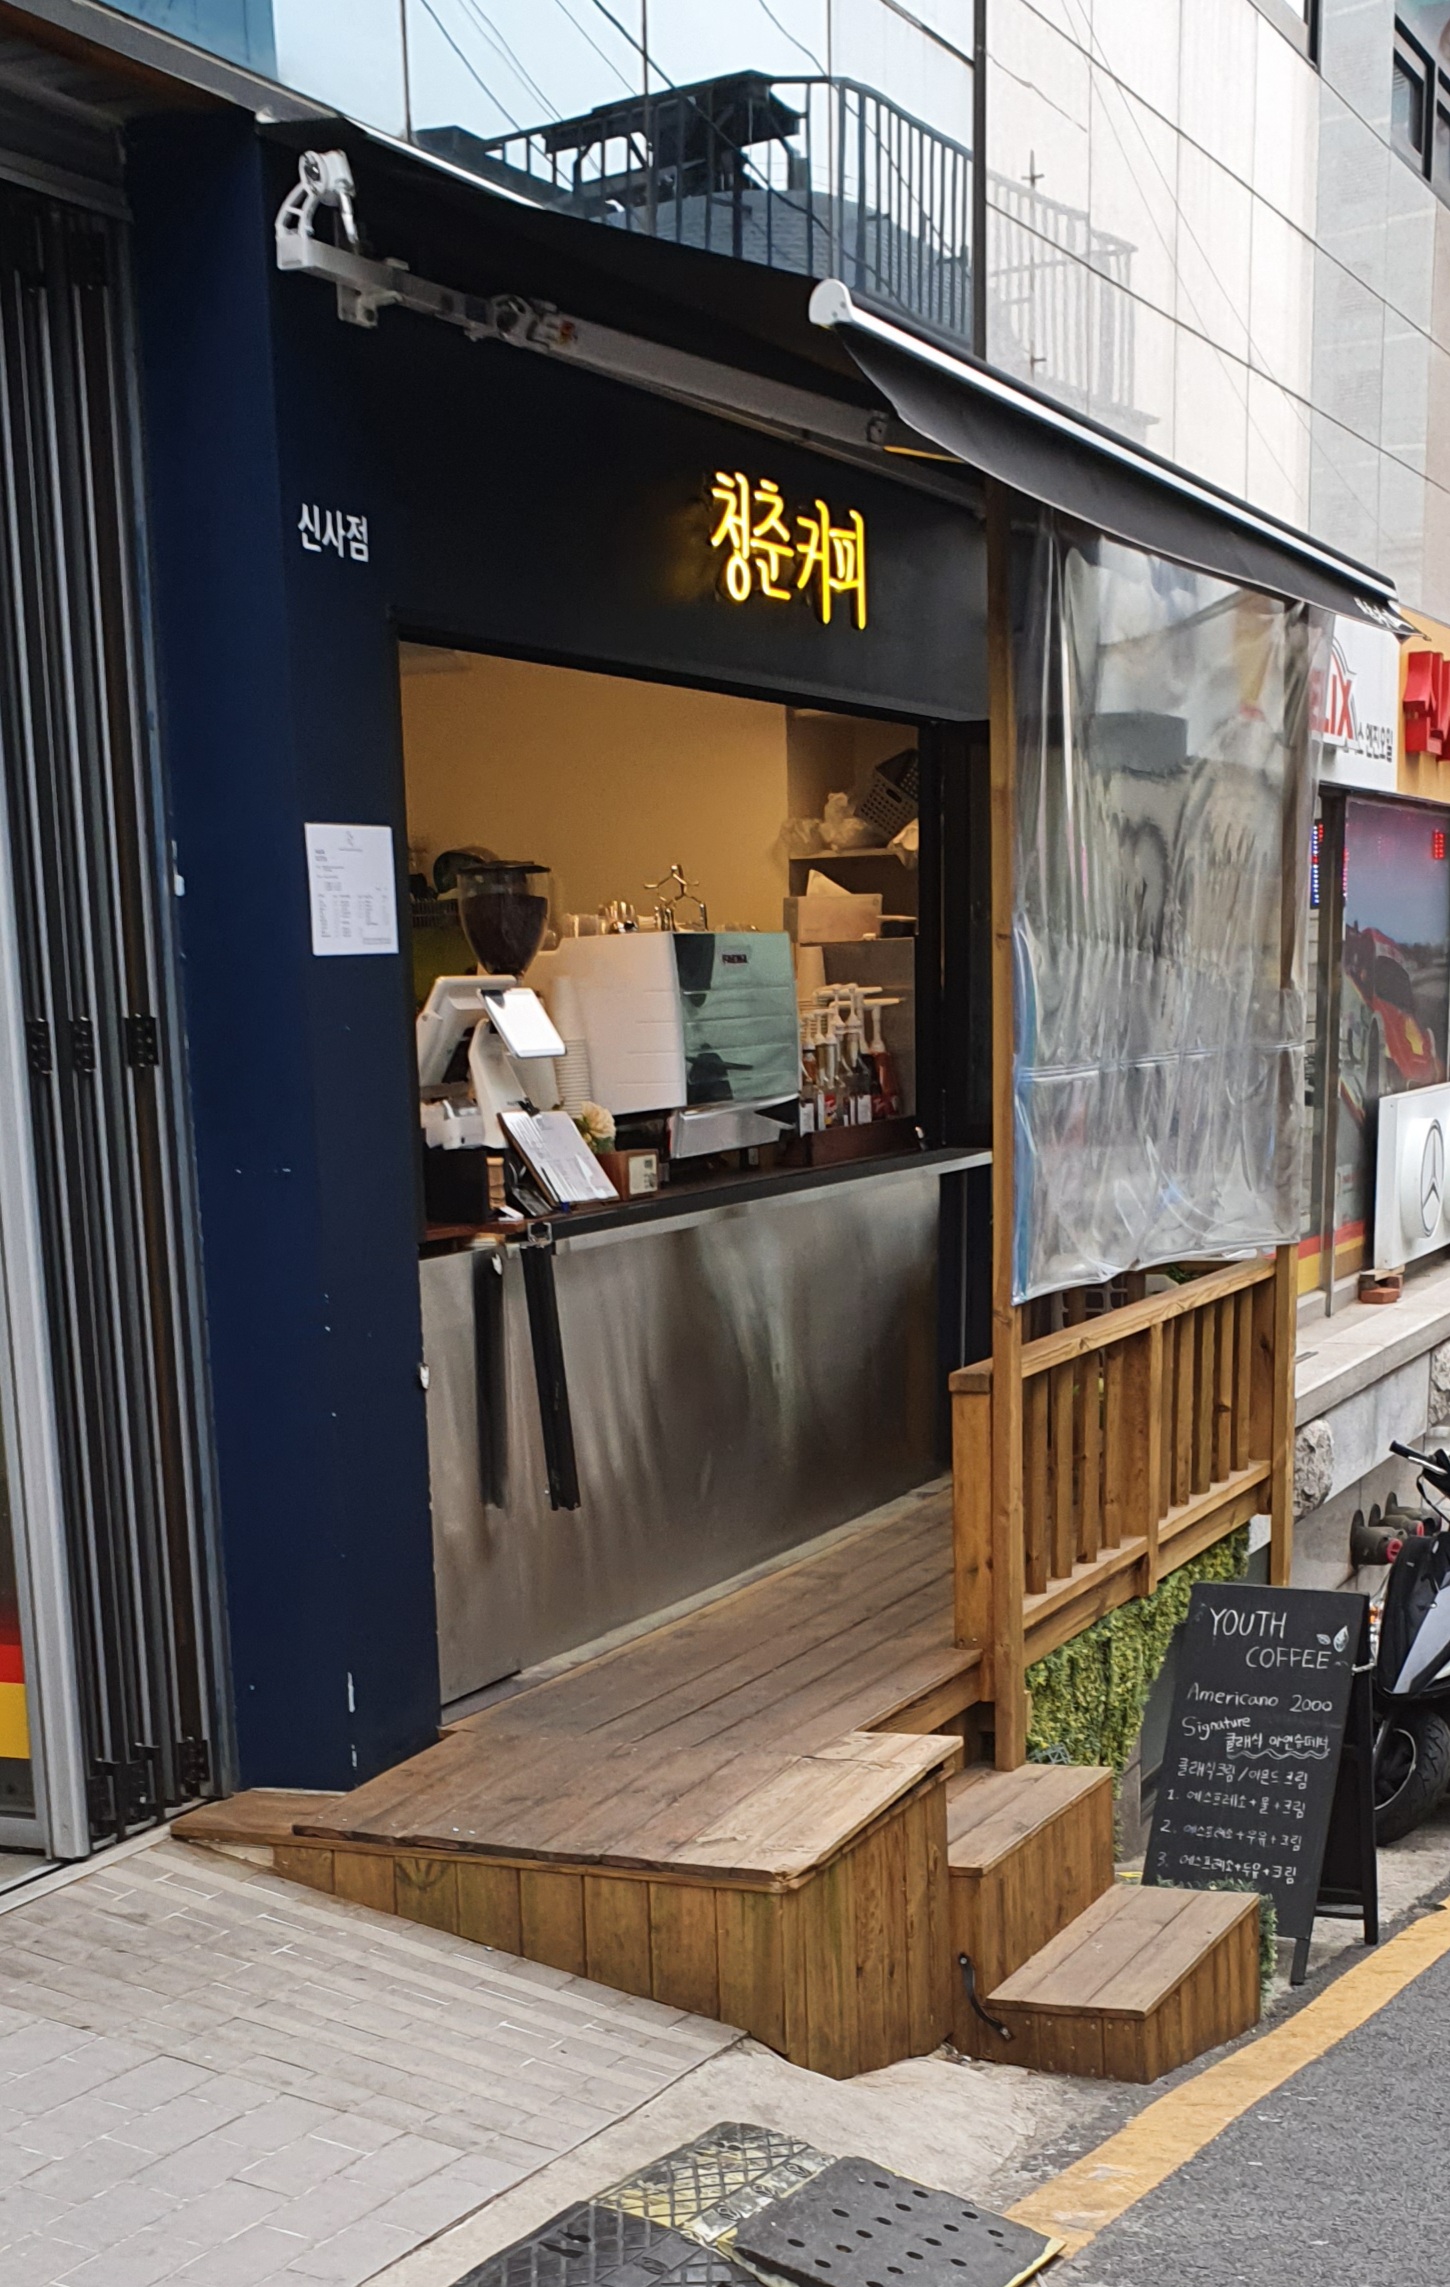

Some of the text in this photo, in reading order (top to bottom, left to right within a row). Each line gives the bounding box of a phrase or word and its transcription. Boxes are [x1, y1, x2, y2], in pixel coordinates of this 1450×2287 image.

[298, 502, 369, 563] 신사점
[1210, 1607, 1287, 1639] YOUTH
[1245, 1646, 1332, 1669] COFFEE
[1187, 1682, 1333, 1713] Americano 2000
[1181, 1716, 1251, 1741] Signature
[1225, 1732, 1263, 1752] 클래식
